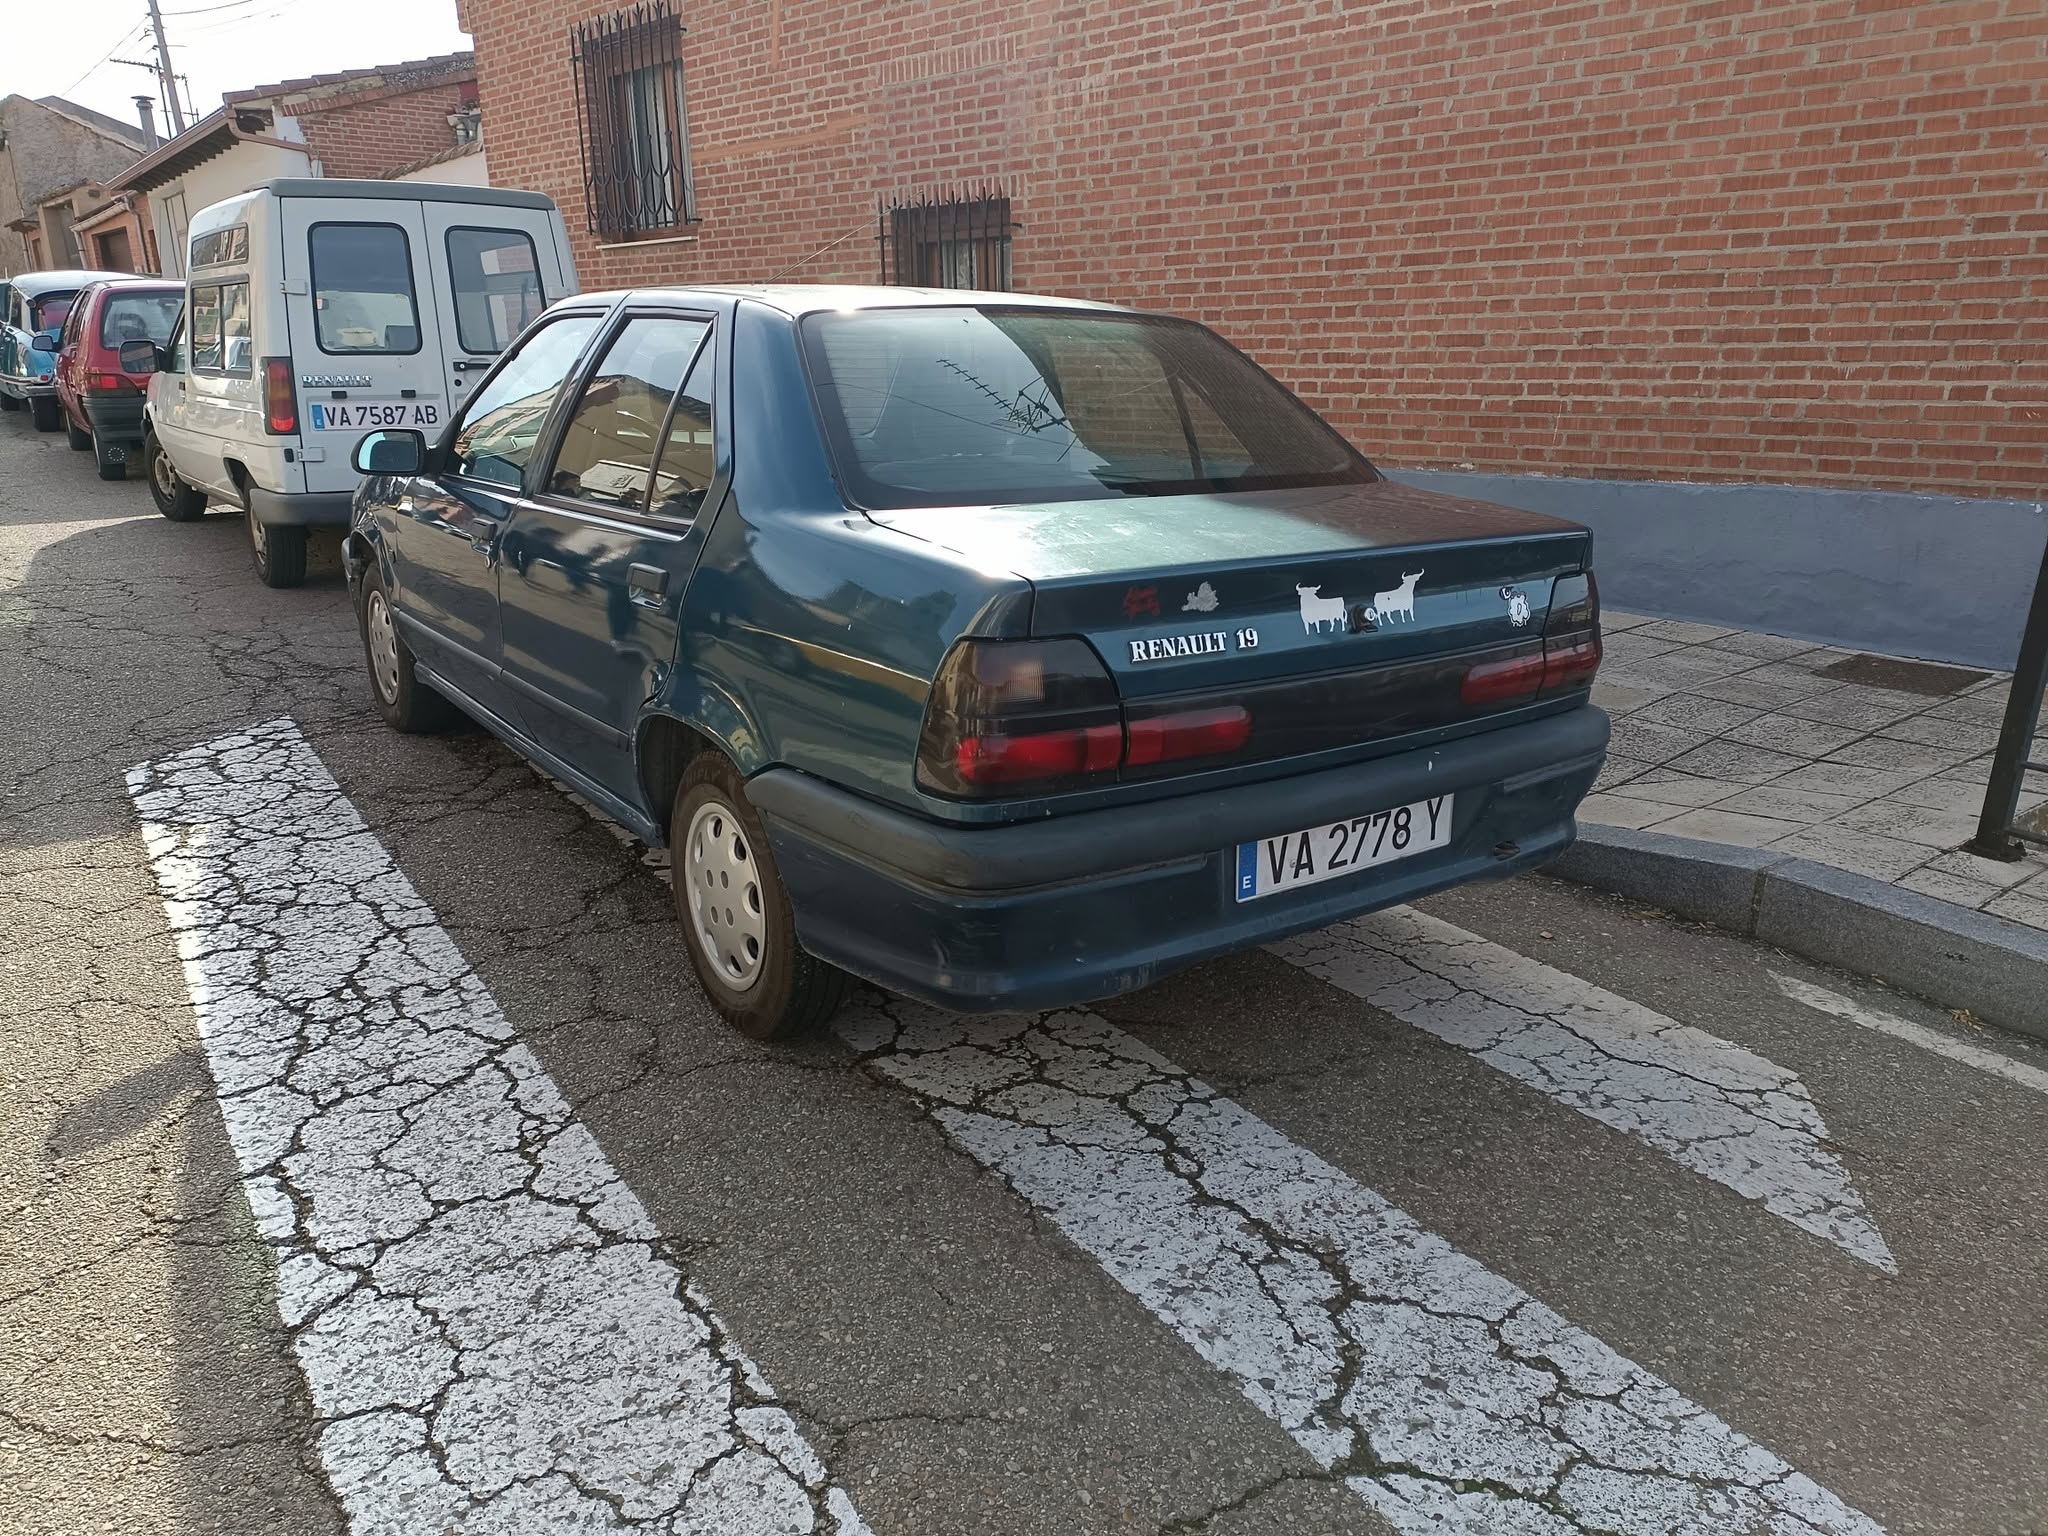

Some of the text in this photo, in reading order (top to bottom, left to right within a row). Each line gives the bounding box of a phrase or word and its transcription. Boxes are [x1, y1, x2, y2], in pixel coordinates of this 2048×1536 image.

[302, 375, 372, 388] RENAULT
[324, 407, 351, 426] VA
[356, 406, 406, 425] 7587
[414, 405, 438, 424] AB
[1129, 627, 1259, 662] RENAULT 19
[1242, 796, 1444, 889] E VA 2778 Y
